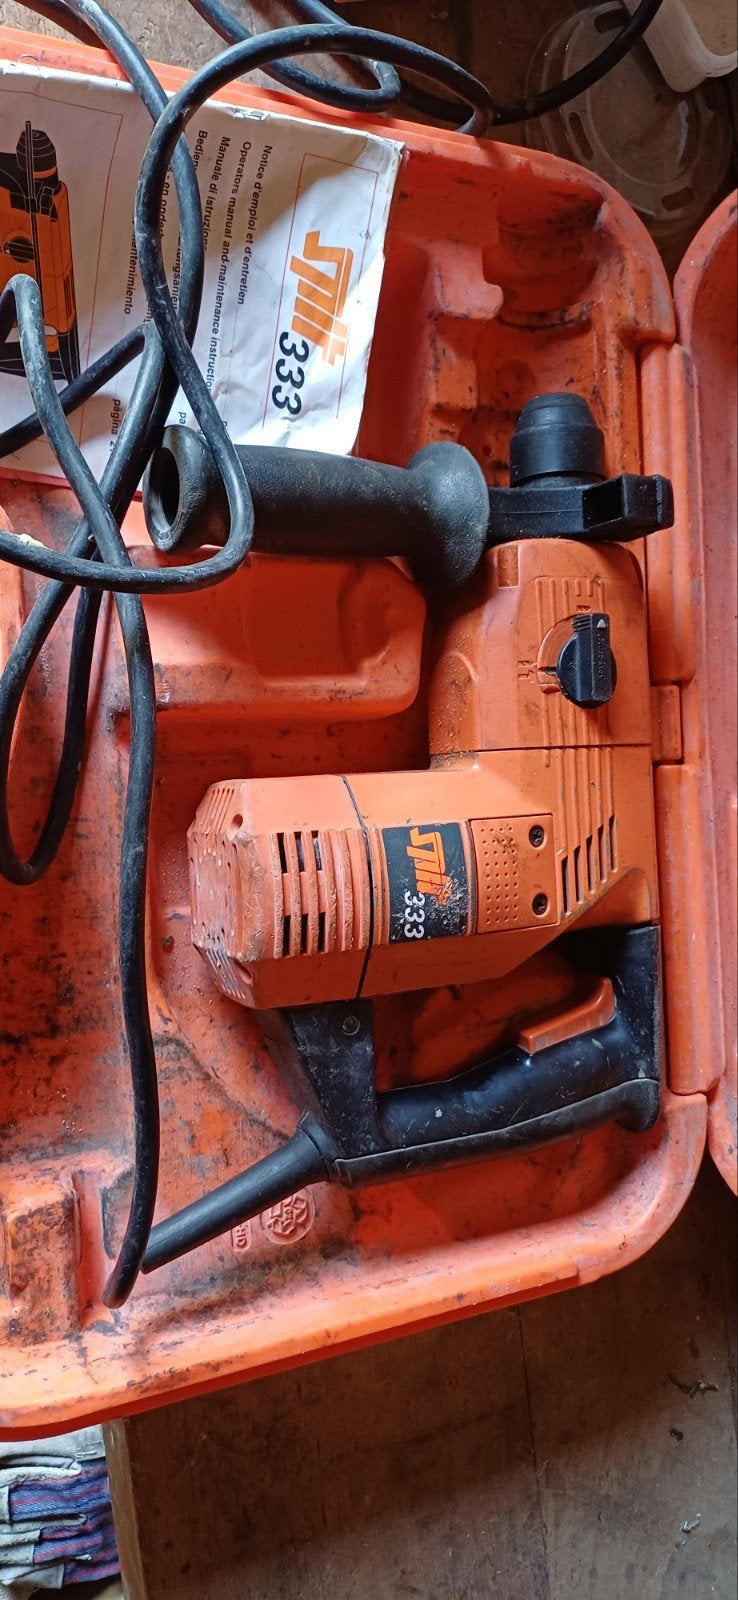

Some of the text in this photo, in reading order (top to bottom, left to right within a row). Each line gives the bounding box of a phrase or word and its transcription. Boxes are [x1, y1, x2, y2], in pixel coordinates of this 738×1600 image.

[193, 130, 208, 171] Bedien
[211, 136, 231, 181] Manuale
[231, 141, 252, 194] Operators
[208, 183, 218, 194] di
[224, 197, 236, 239] manual
[238, 145, 273, 305] Notice d'emploi et d'entretien
[212, 264, 228, 334] maintenance
[272, 331, 309, 415] 333
[404, 890, 426, 939] 333
